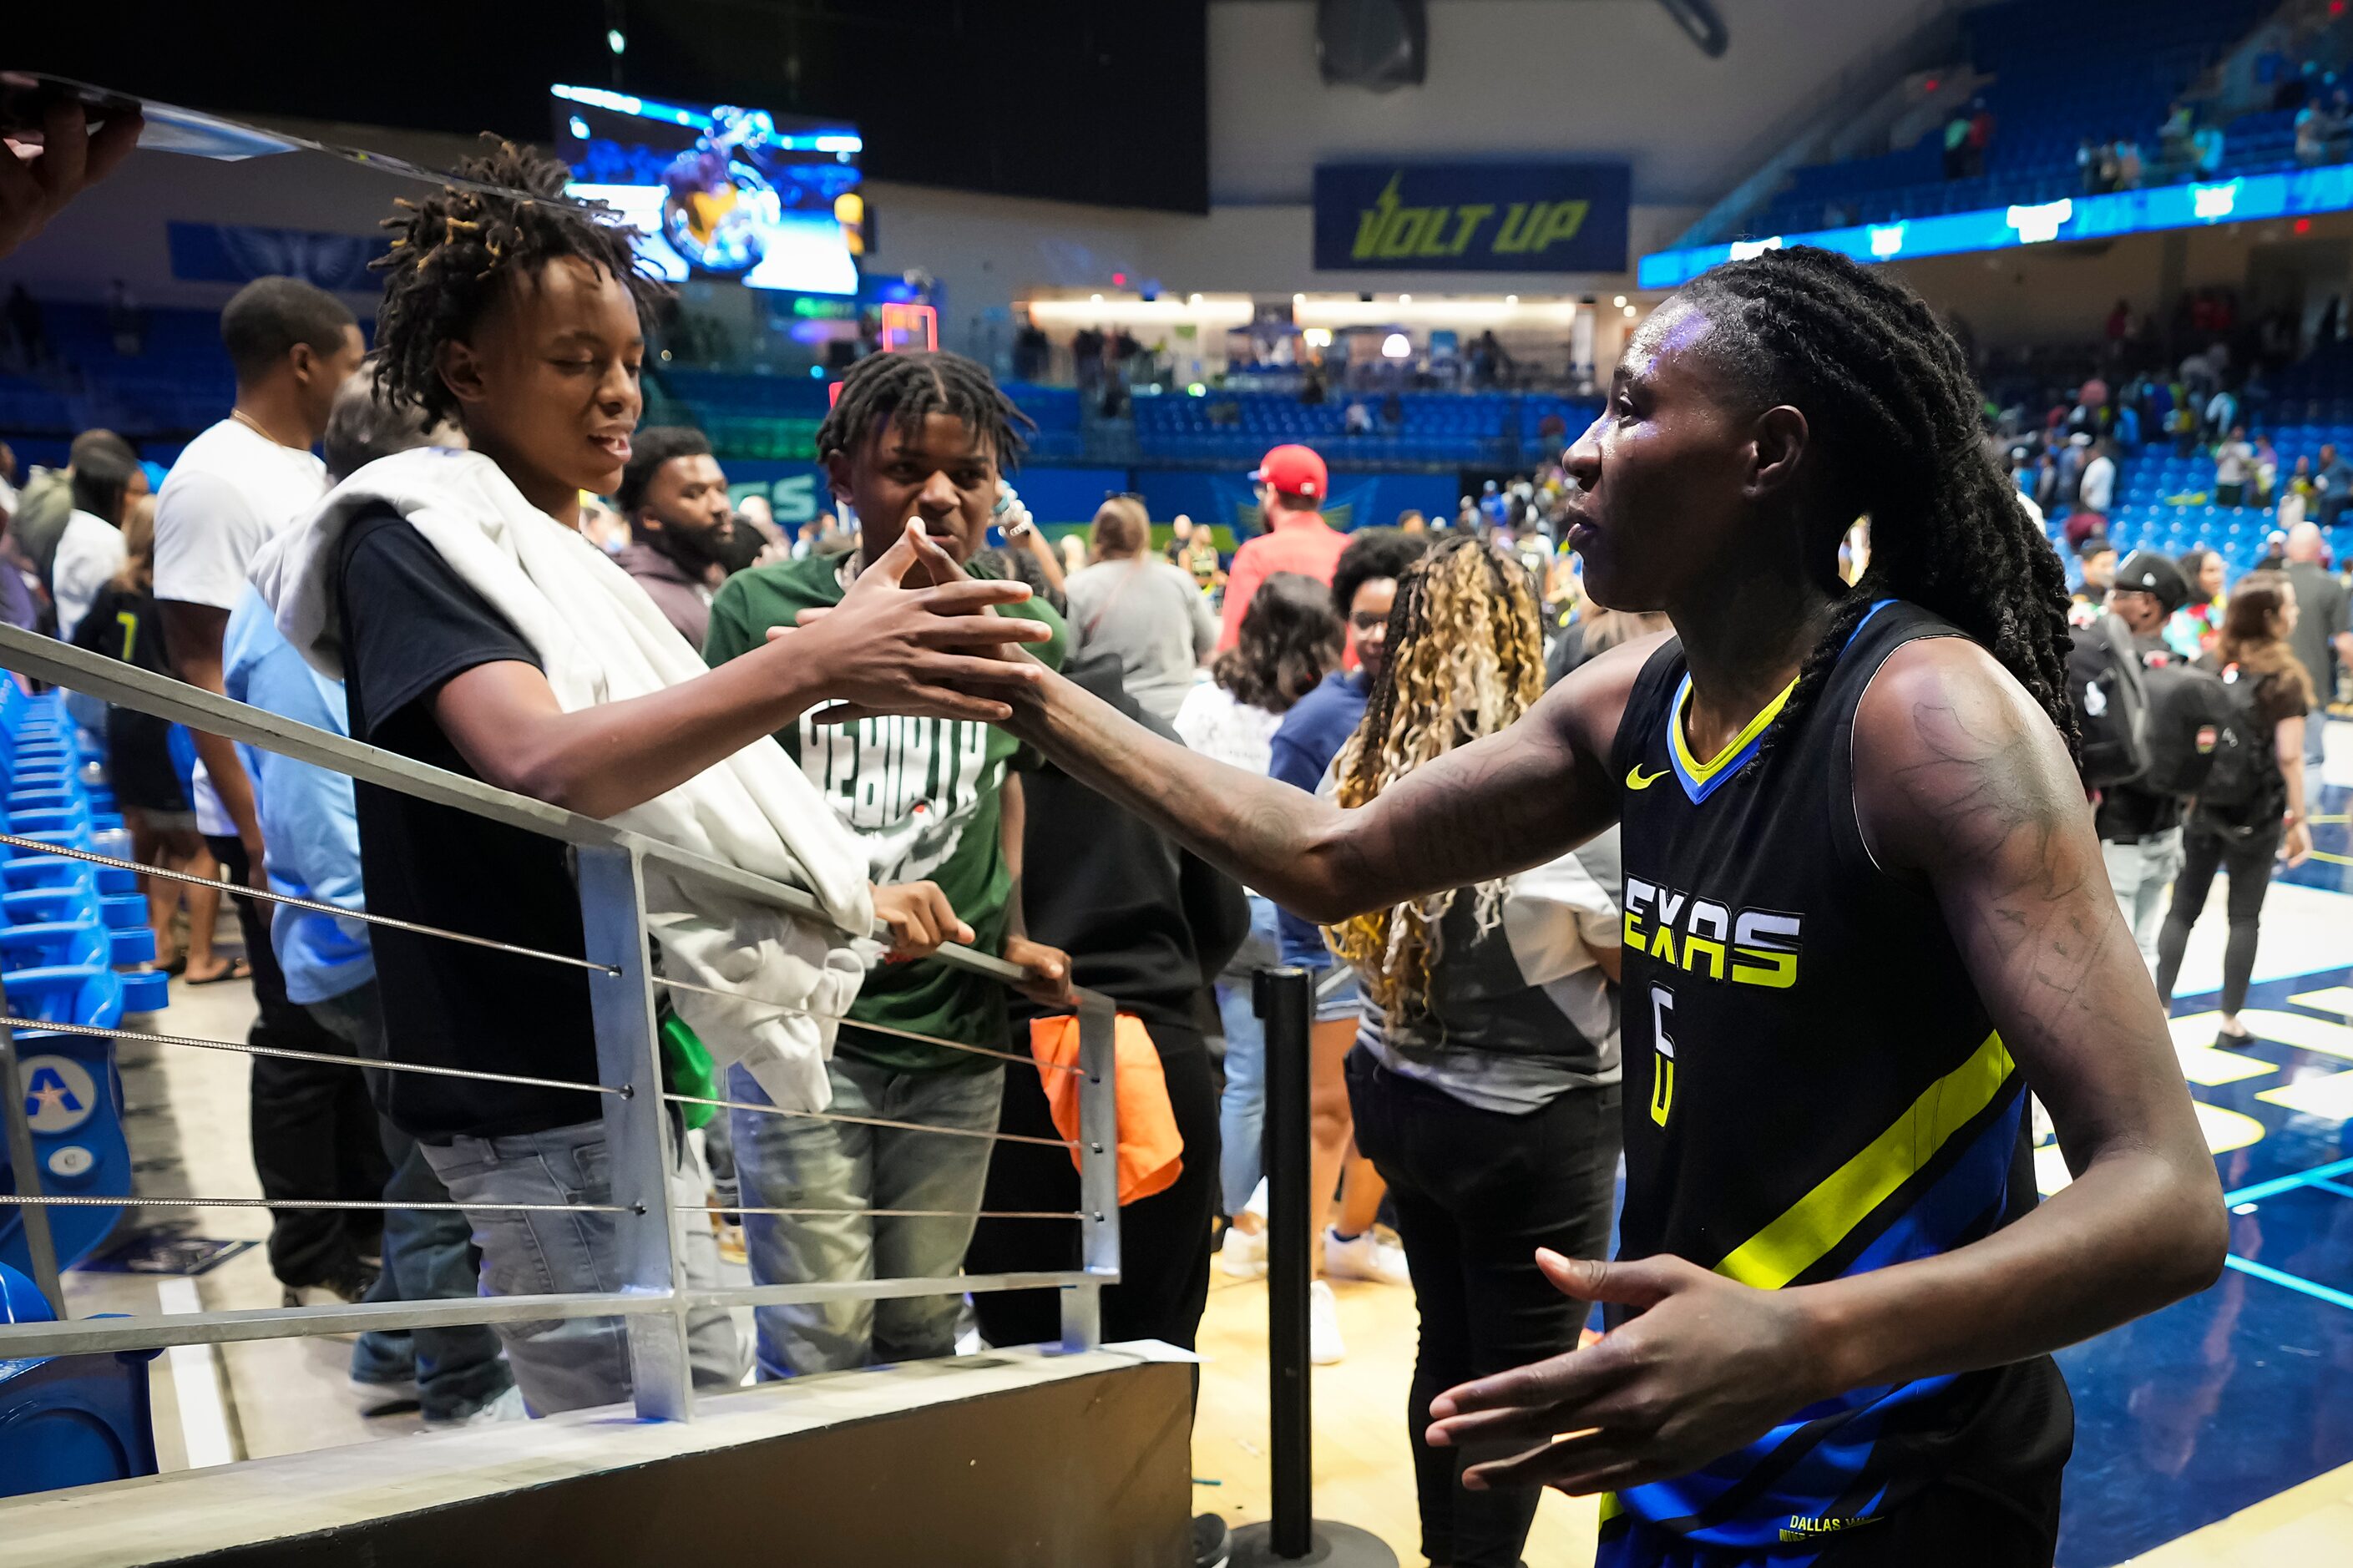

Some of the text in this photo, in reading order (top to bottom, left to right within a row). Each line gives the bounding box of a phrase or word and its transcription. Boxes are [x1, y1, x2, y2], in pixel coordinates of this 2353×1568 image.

[1351, 169, 1590, 260] VOLT UP
[1789, 1515, 1841, 1532] DALLAS
